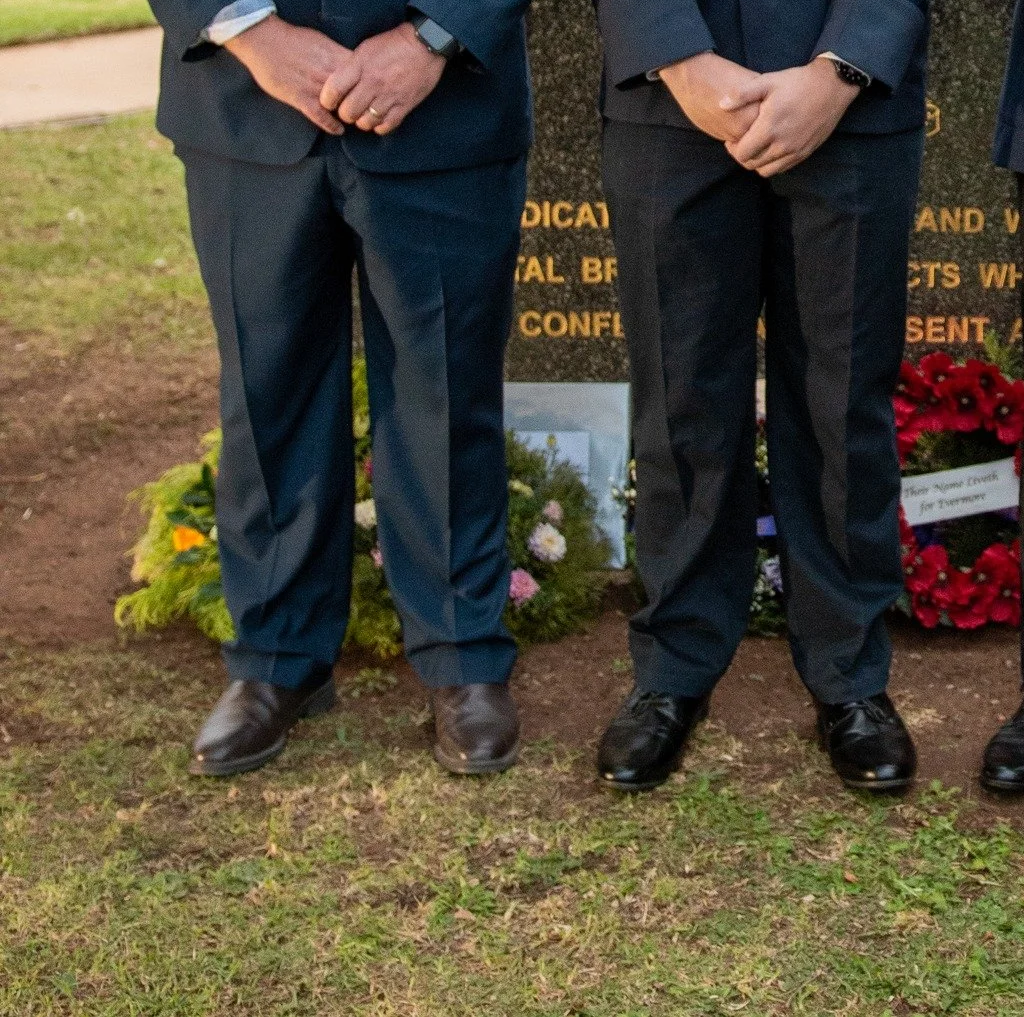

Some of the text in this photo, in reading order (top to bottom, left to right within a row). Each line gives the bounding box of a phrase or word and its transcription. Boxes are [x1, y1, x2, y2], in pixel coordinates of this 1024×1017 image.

[915, 206, 985, 233] AND
[905, 315, 990, 344] SENT
[918, 499, 934, 516] for
